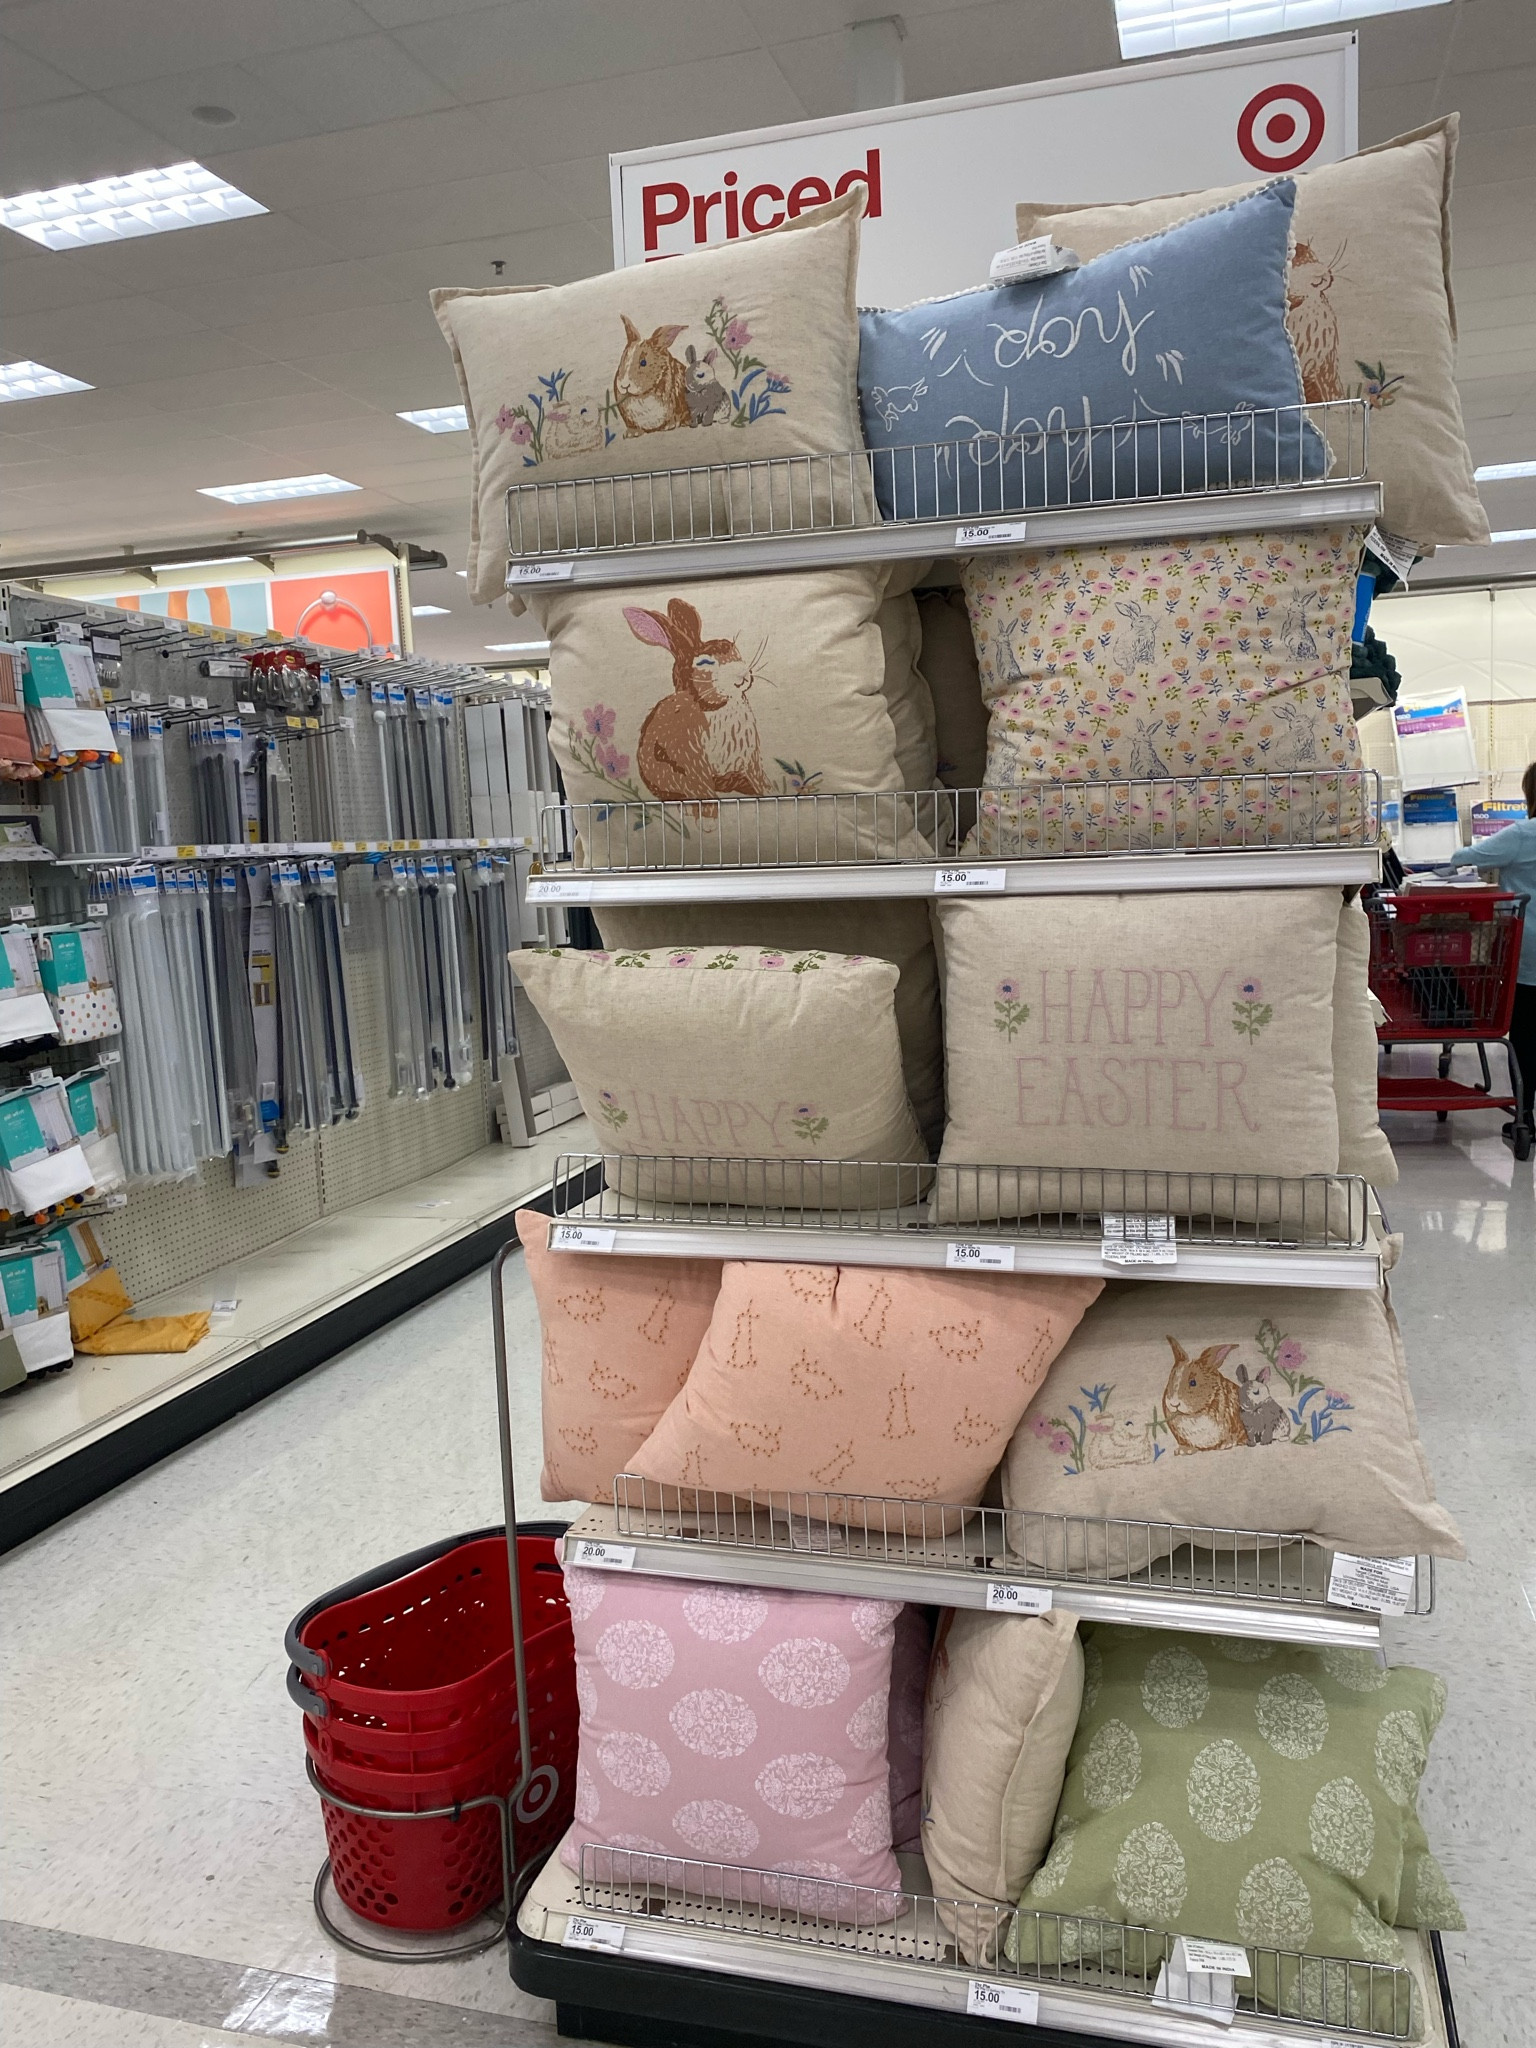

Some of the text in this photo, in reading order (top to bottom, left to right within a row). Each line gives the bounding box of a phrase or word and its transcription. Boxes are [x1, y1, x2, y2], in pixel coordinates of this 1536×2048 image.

[642, 148, 882, 251] Priced
[963, 529, 989, 538] 15.00
[519, 567, 542, 575] 15.00
[1482, 801, 1528, 811] Filtret
[942, 873, 967, 882] 15.00
[538, 885, 561, 893] 20.00
[1039, 968, 1233, 1047] HAPPY
[1015, 1057, 1262, 1132] EASTER
[630, 1090, 790, 1148] HAPPY
[561, 1230, 583, 1240] 15.00
[955, 1248, 981, 1258] 15.00
[583, 1546, 606, 1557] 20.00
[993, 1589, 1018, 1600] 20.00
[572, 1925, 594, 1937] 15.00
[974, 1990, 1000, 2004] 15.00
